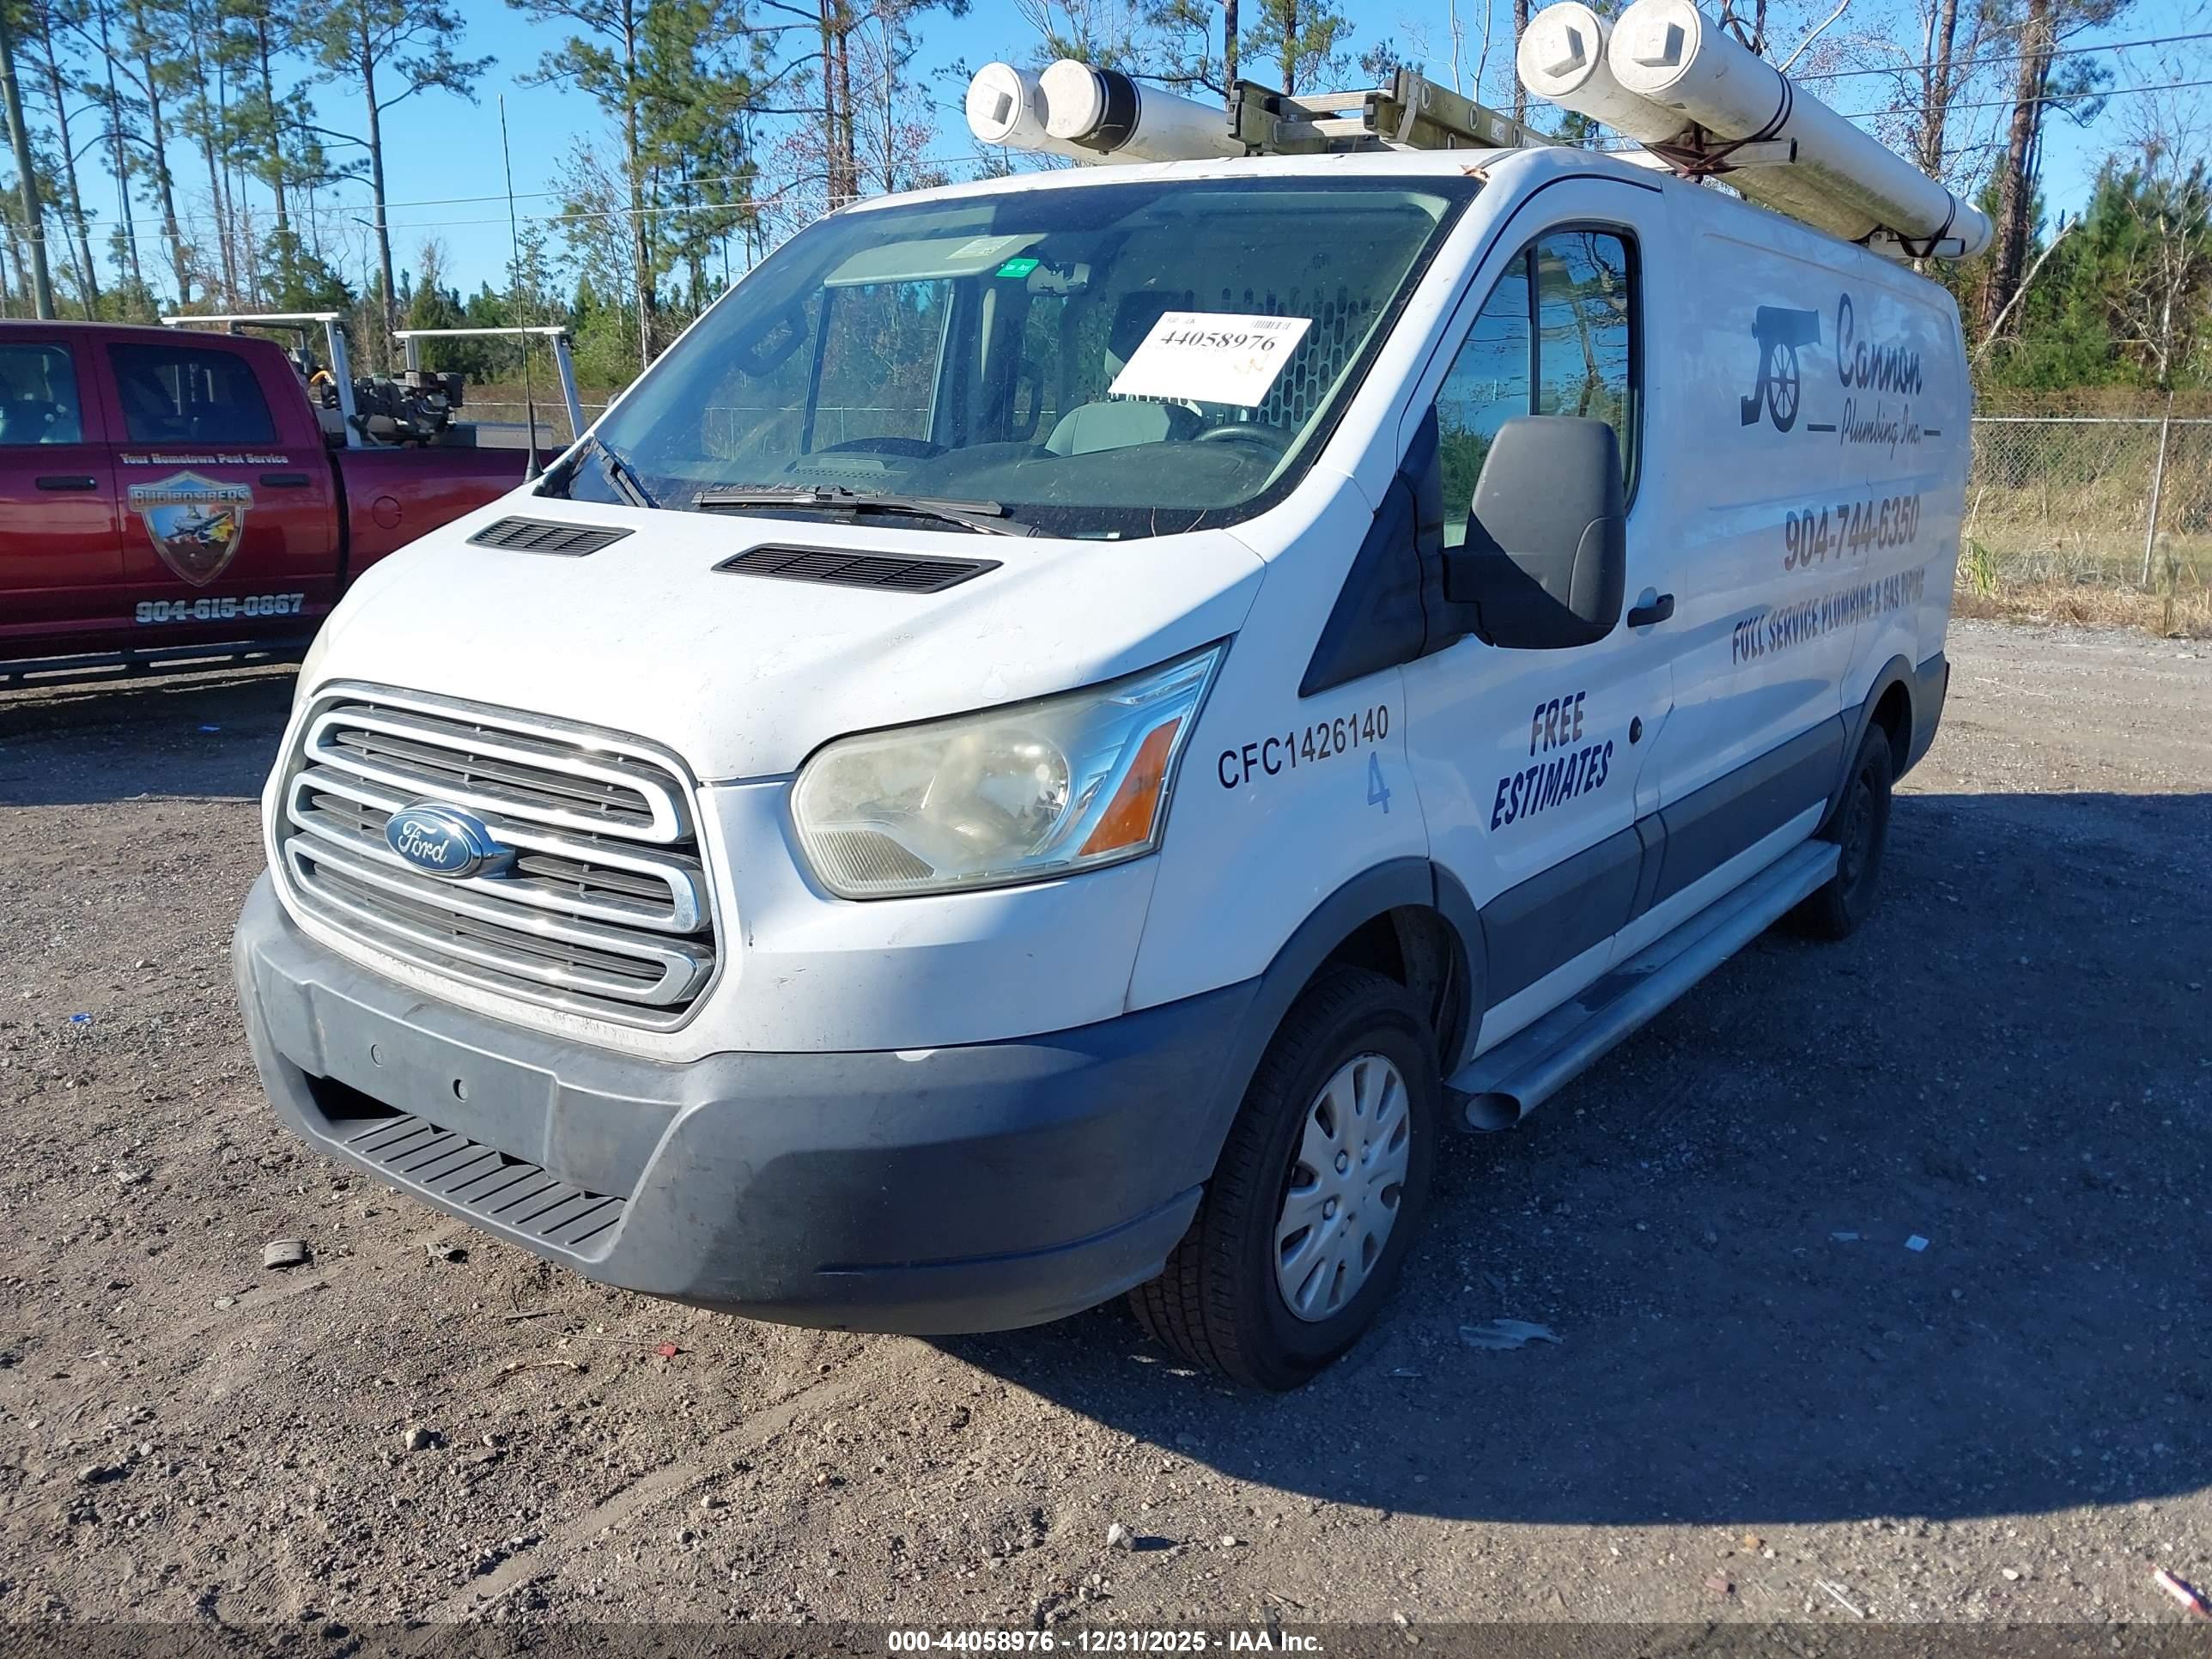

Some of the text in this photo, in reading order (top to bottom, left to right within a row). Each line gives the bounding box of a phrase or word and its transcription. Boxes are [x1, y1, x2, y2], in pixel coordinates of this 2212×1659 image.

[1161, 330, 1279, 351] 44058976
[1837, 293, 1922, 396] Cannon
[119, 453, 289, 464] Your Hometown Pest Service
[1840, 397, 1921, 460] Plumbing Inc.
[131, 486, 250, 506] BUG BOMBERS
[1784, 495, 1920, 571] 904-744-6350
[136, 592, 304, 623] 904-615-0867
[1732, 614, 1765, 665] FULL
[1768, 598, 1819, 653] SERVICE
[1821, 583, 1873, 634] PLUMBING
[1875, 580, 1881, 614] &
[1884, 574, 1899, 612] GAS
[1218, 705, 1389, 789] CFC1426140
[1529, 690, 1586, 757] FREE
[1367, 751, 1391, 814] 4
[1491, 739, 1613, 831] ESTIMATES
[398, 821, 450, 864] Ford
